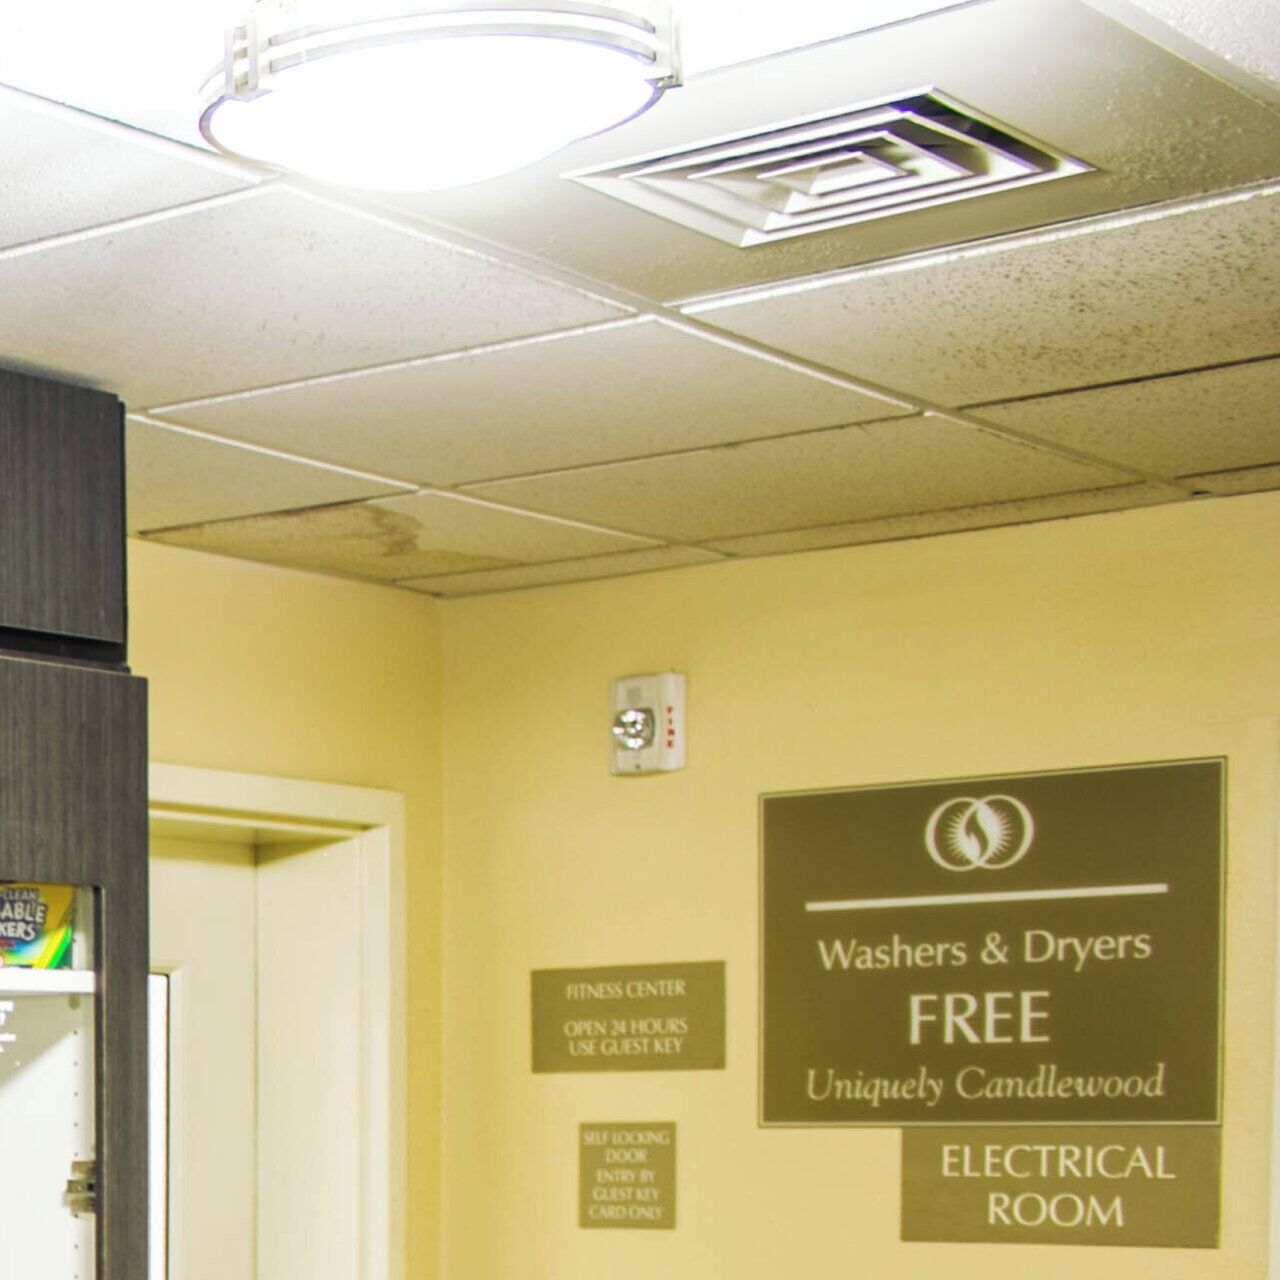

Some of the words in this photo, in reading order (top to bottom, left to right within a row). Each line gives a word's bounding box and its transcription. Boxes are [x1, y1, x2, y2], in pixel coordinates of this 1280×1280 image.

[816, 933, 968, 971] Washers
[979, 931, 1009, 965] &
[1023, 928, 1153, 973] Dryers
[566, 981, 624, 1000] FITNESS
[626, 979, 687, 999] CENTER
[563, 1020, 607, 1038] OPEN
[610, 1019, 627, 1037] 24
[631, 1017, 689, 1036] HOURS
[909, 989, 1051, 1045] FREE
[568, 1039, 596, 1057] USE
[600, 1038, 650, 1056] GUEST
[653, 1036, 684, 1055] KEY
[806, 1065, 944, 1107] Uniquely
[954, 1061, 1166, 1100] Candlewood
[941, 1143, 1176, 1180] ELECTRICAL
[987, 1191, 1126, 1228] ROOM
